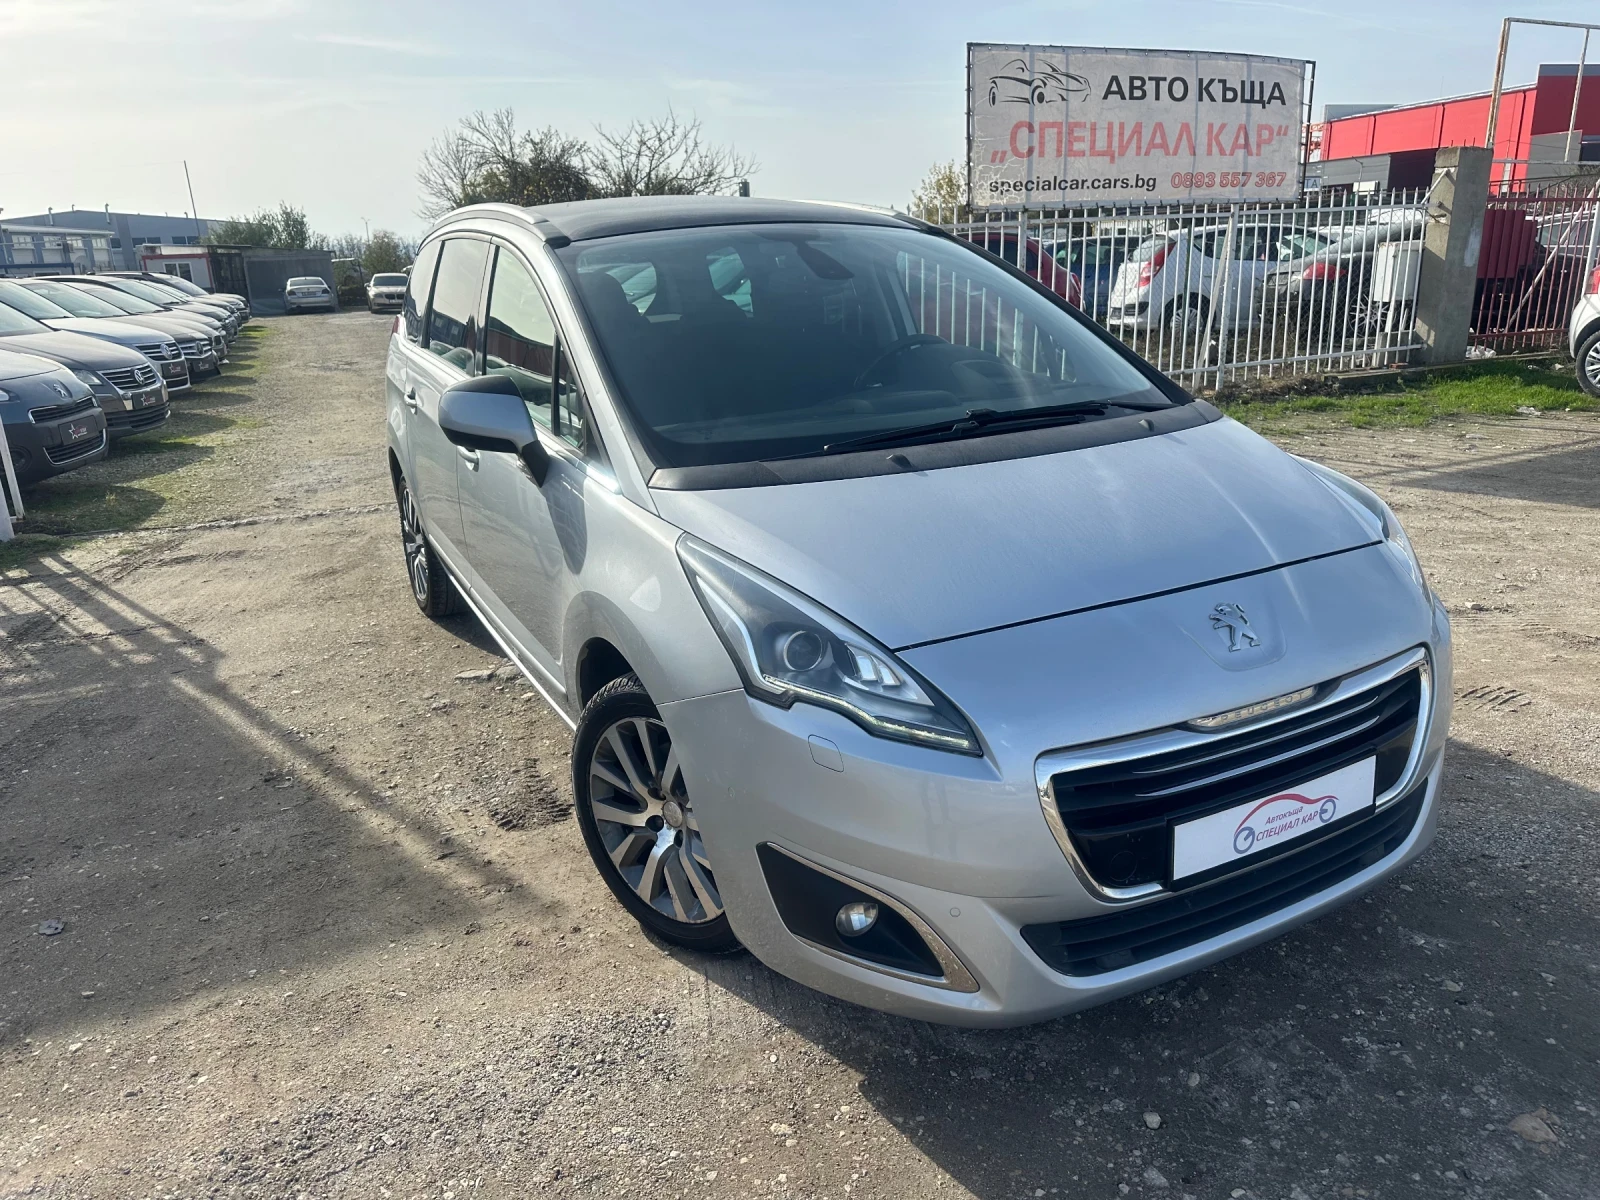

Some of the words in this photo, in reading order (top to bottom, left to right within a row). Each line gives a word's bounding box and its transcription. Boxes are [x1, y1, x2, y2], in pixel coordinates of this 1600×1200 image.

[1102, 75, 1189, 102] АВТО
[1198, 78, 1286, 109] КЪЩА
[989, 174, 1157, 196] specialcar.cars.bg
[1170, 171, 1217, 189] 0893
[1219, 171, 1253, 188] 557
[1255, 171, 1287, 188] 367
[1220, 691, 1305, 721] PEUGEOT
[1256, 818, 1301, 842] СПЕЦИАЛ
[1301, 810, 1319, 825] КАР
[1264, 806, 1304, 826] Автокъща
